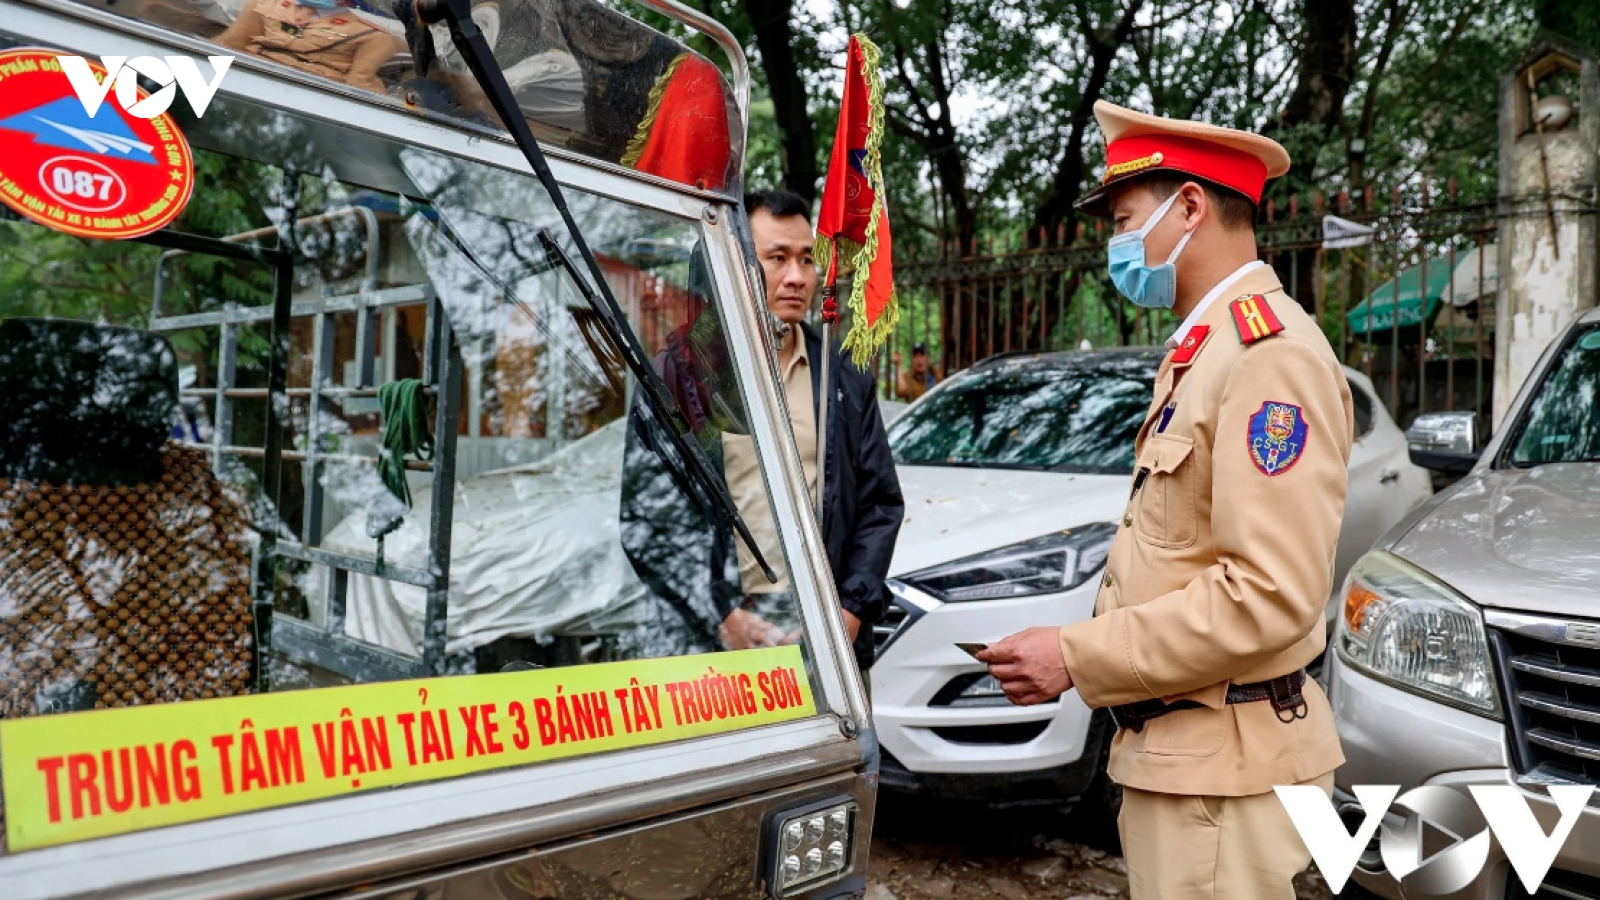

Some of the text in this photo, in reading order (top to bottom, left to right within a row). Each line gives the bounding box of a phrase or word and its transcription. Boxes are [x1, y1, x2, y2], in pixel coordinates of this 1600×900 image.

[52, 166, 114, 201] 087
[36, 665, 804, 824] TRUNG TÂM VẬN TẢI XE 3 BÁNH TÂY TRƯỜNG SƠN
